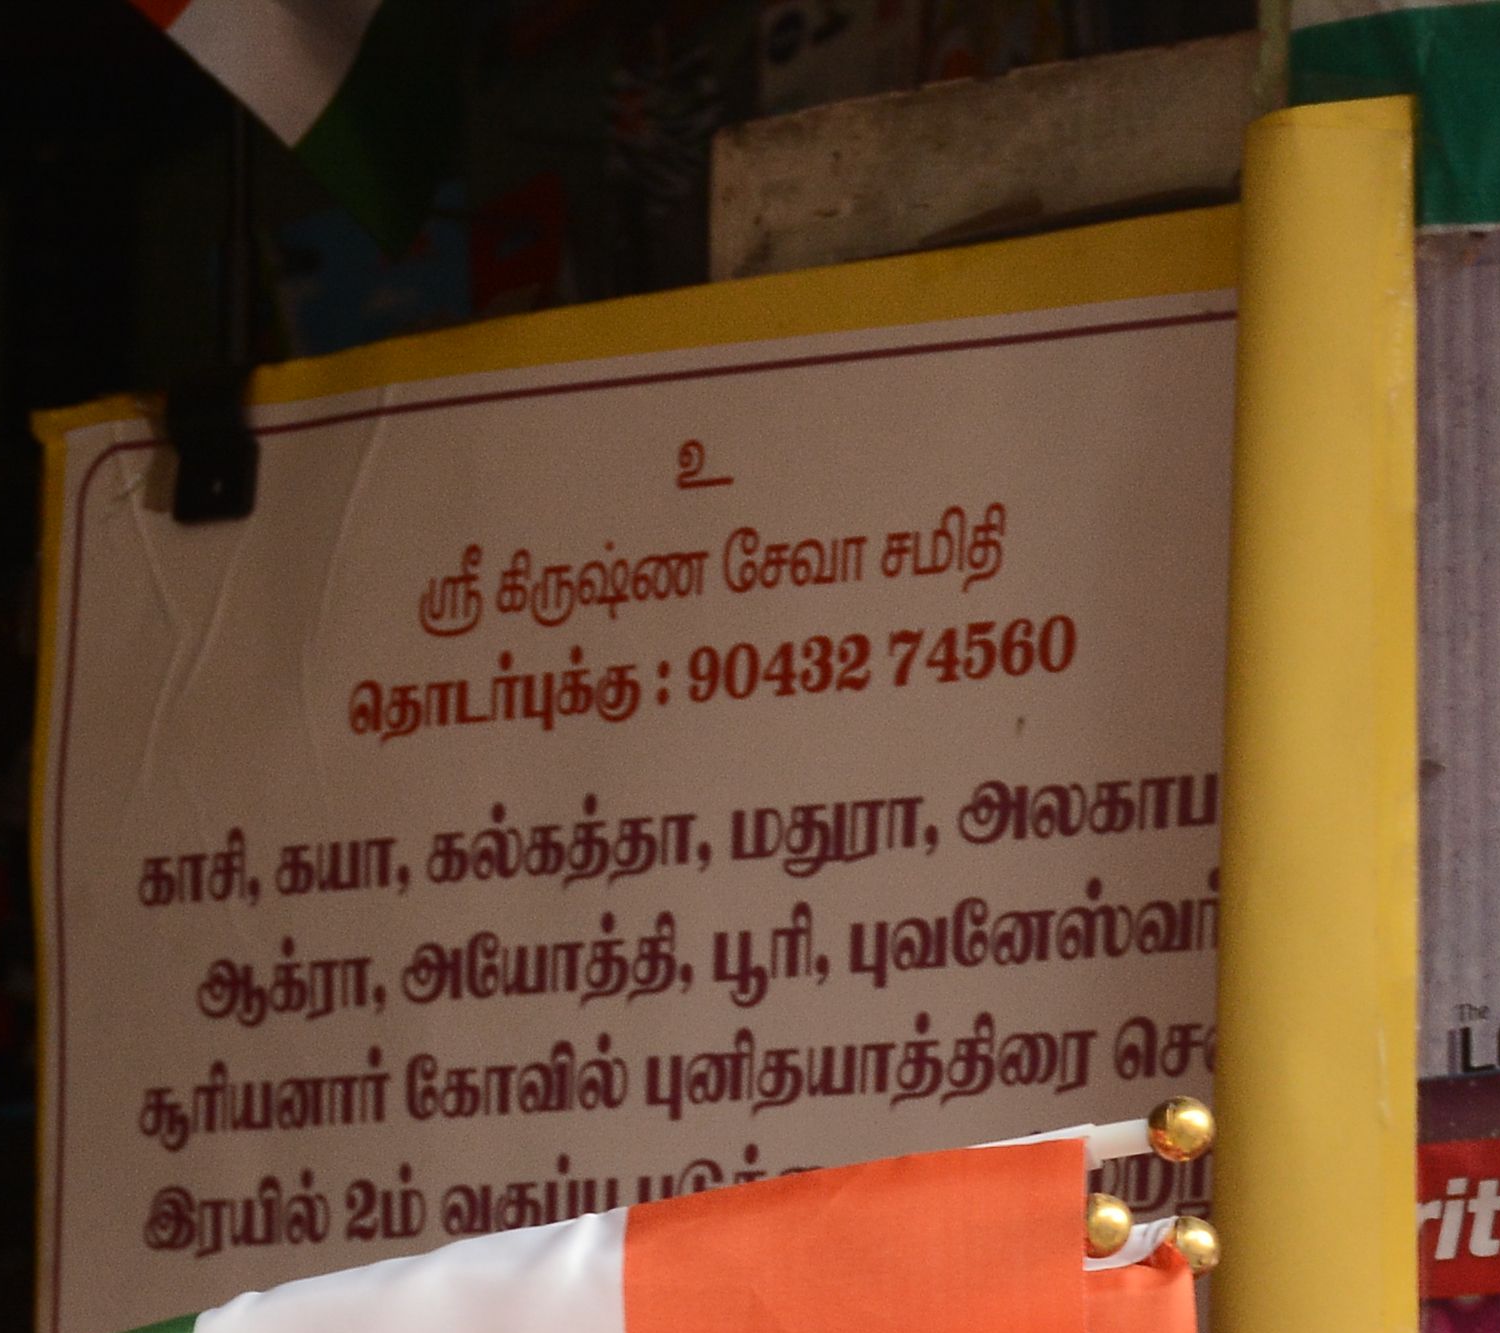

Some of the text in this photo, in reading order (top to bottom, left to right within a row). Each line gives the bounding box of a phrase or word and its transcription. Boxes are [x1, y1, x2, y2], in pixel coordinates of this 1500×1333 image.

[494, 540, 708, 627] கிருஷ்ண
[722, 526, 868, 594] சேவா
[880, 502, 1007, 593] சமிதி
[687, 633, 871, 703] 90432
[887, 614, 1078, 688] 74560
[138, 826, 260, 909] காசி,
[275, 835, 411, 899] கயா,
[426, 792, 712, 893] கல்கத்தா,
[730, 796, 939, 879] மதுரா,
[196, 936, 388, 1029] ஆக்ரா,
[401, 910, 694, 1005] அயோத்தி,
[713, 900, 832, 1009] பூரி,
[1457, 1002, 1491, 1023] The
[137, 1045, 392, 1154] சூரியனார்
[404, 1031, 631, 1123] கோவில்
[645, 1010, 1098, 1122] புனிதயாத்திரை
[143, 1168, 332, 1260] இரயில்
